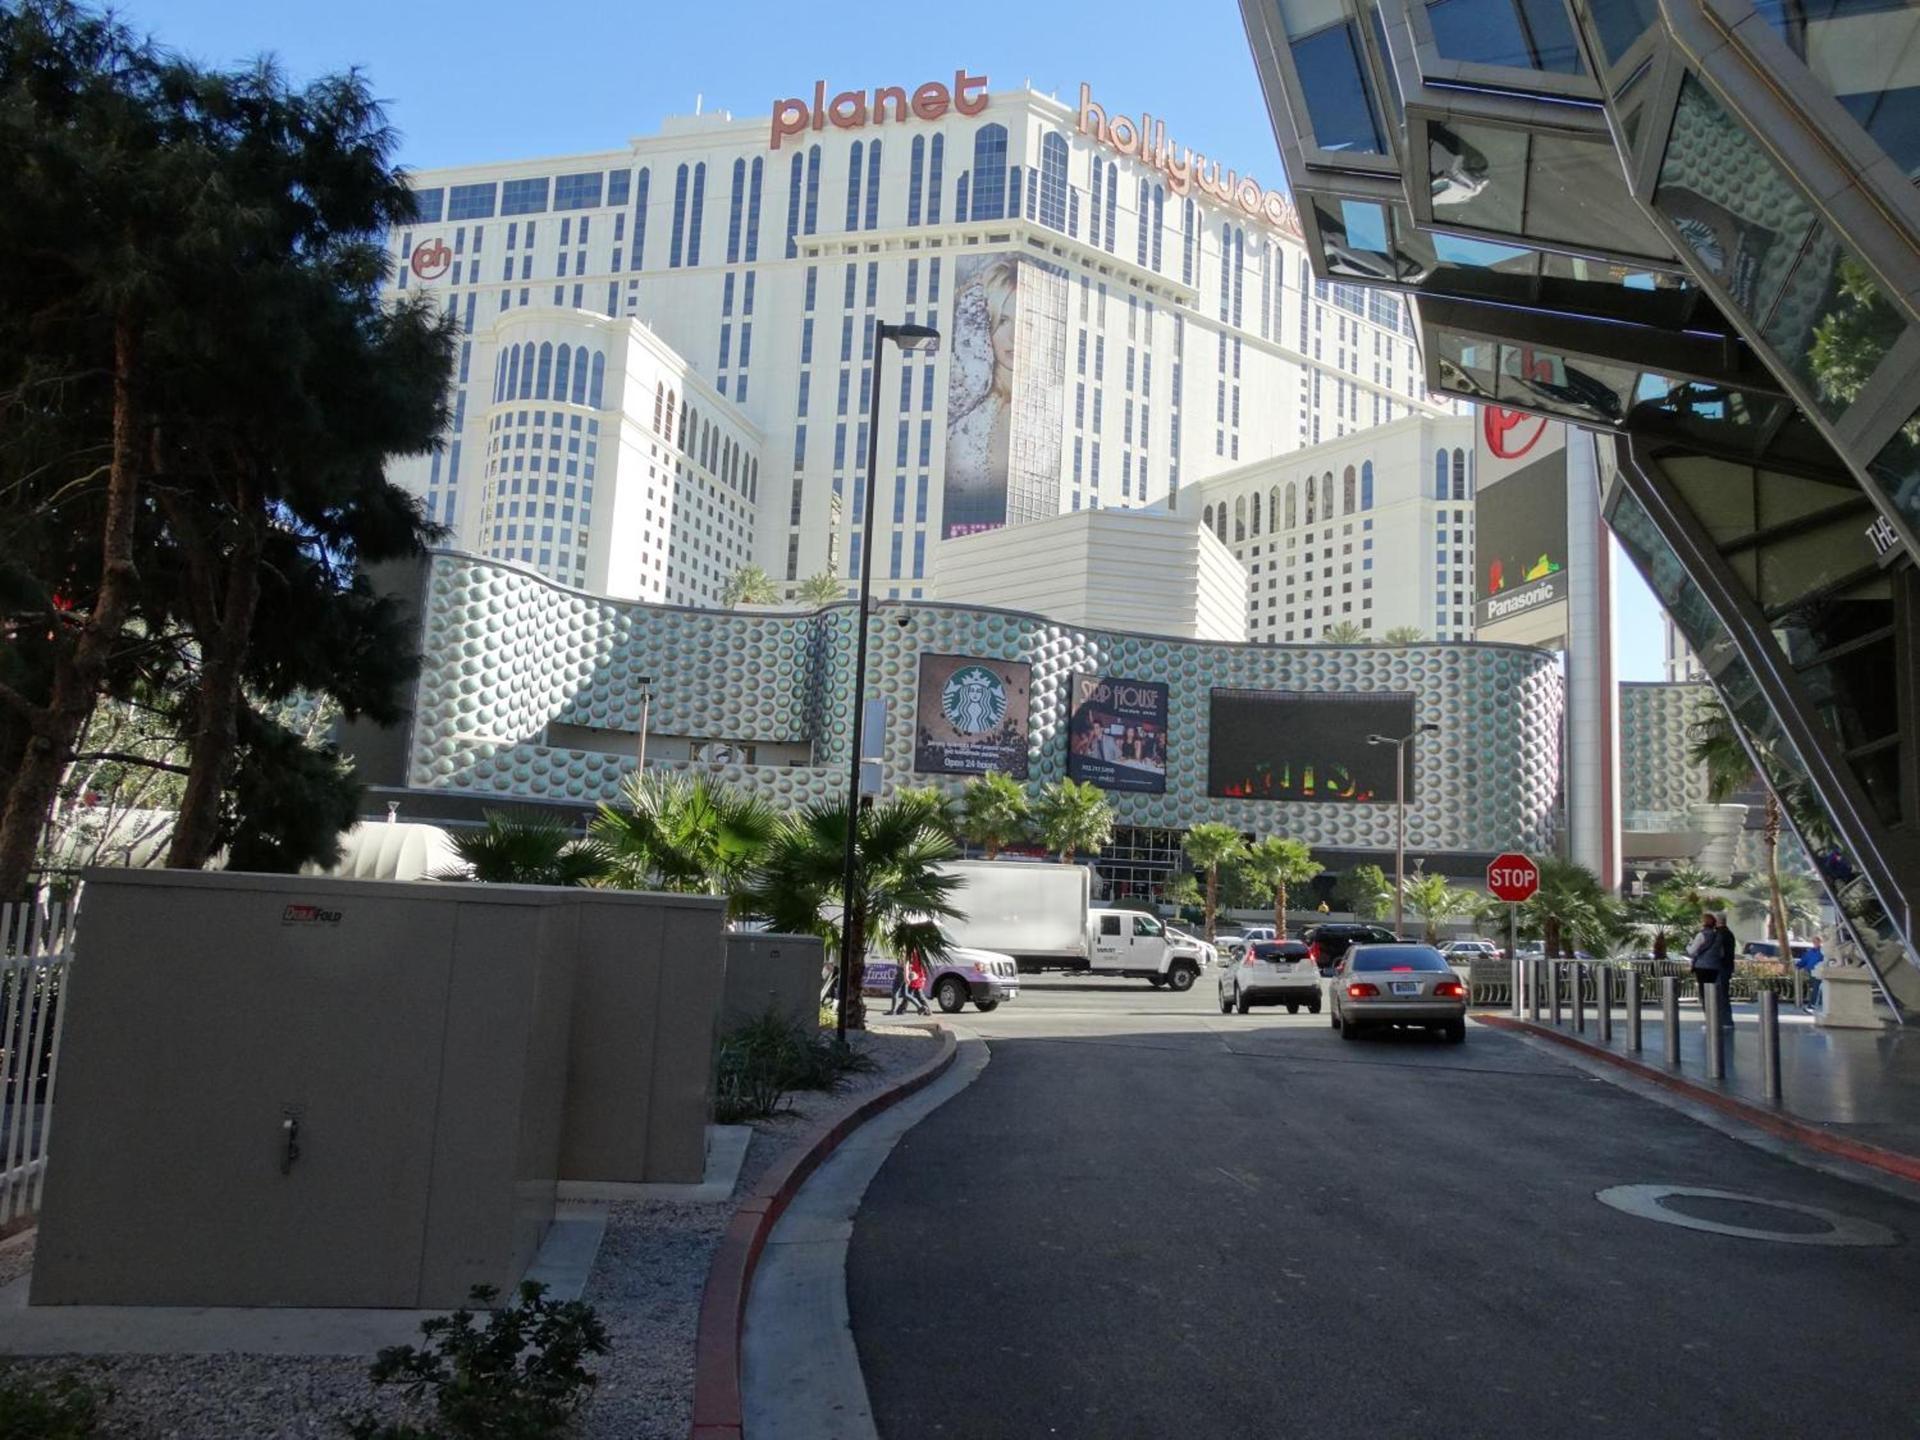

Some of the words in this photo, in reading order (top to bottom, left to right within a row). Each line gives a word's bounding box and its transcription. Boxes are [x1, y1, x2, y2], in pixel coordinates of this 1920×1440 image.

[770, 69, 988, 150] planet
[1078, 82, 1304, 238] hollywoo
[412, 237, 452, 279] ph
[1865, 516, 1899, 555] THE
[1487, 583, 1554, 618] Panasonic
[1113, 685, 1159, 709] HOUSE
[943, 757, 965, 768] Open
[965, 759, 976, 768] 24
[1491, 869, 1535, 887] STOP
